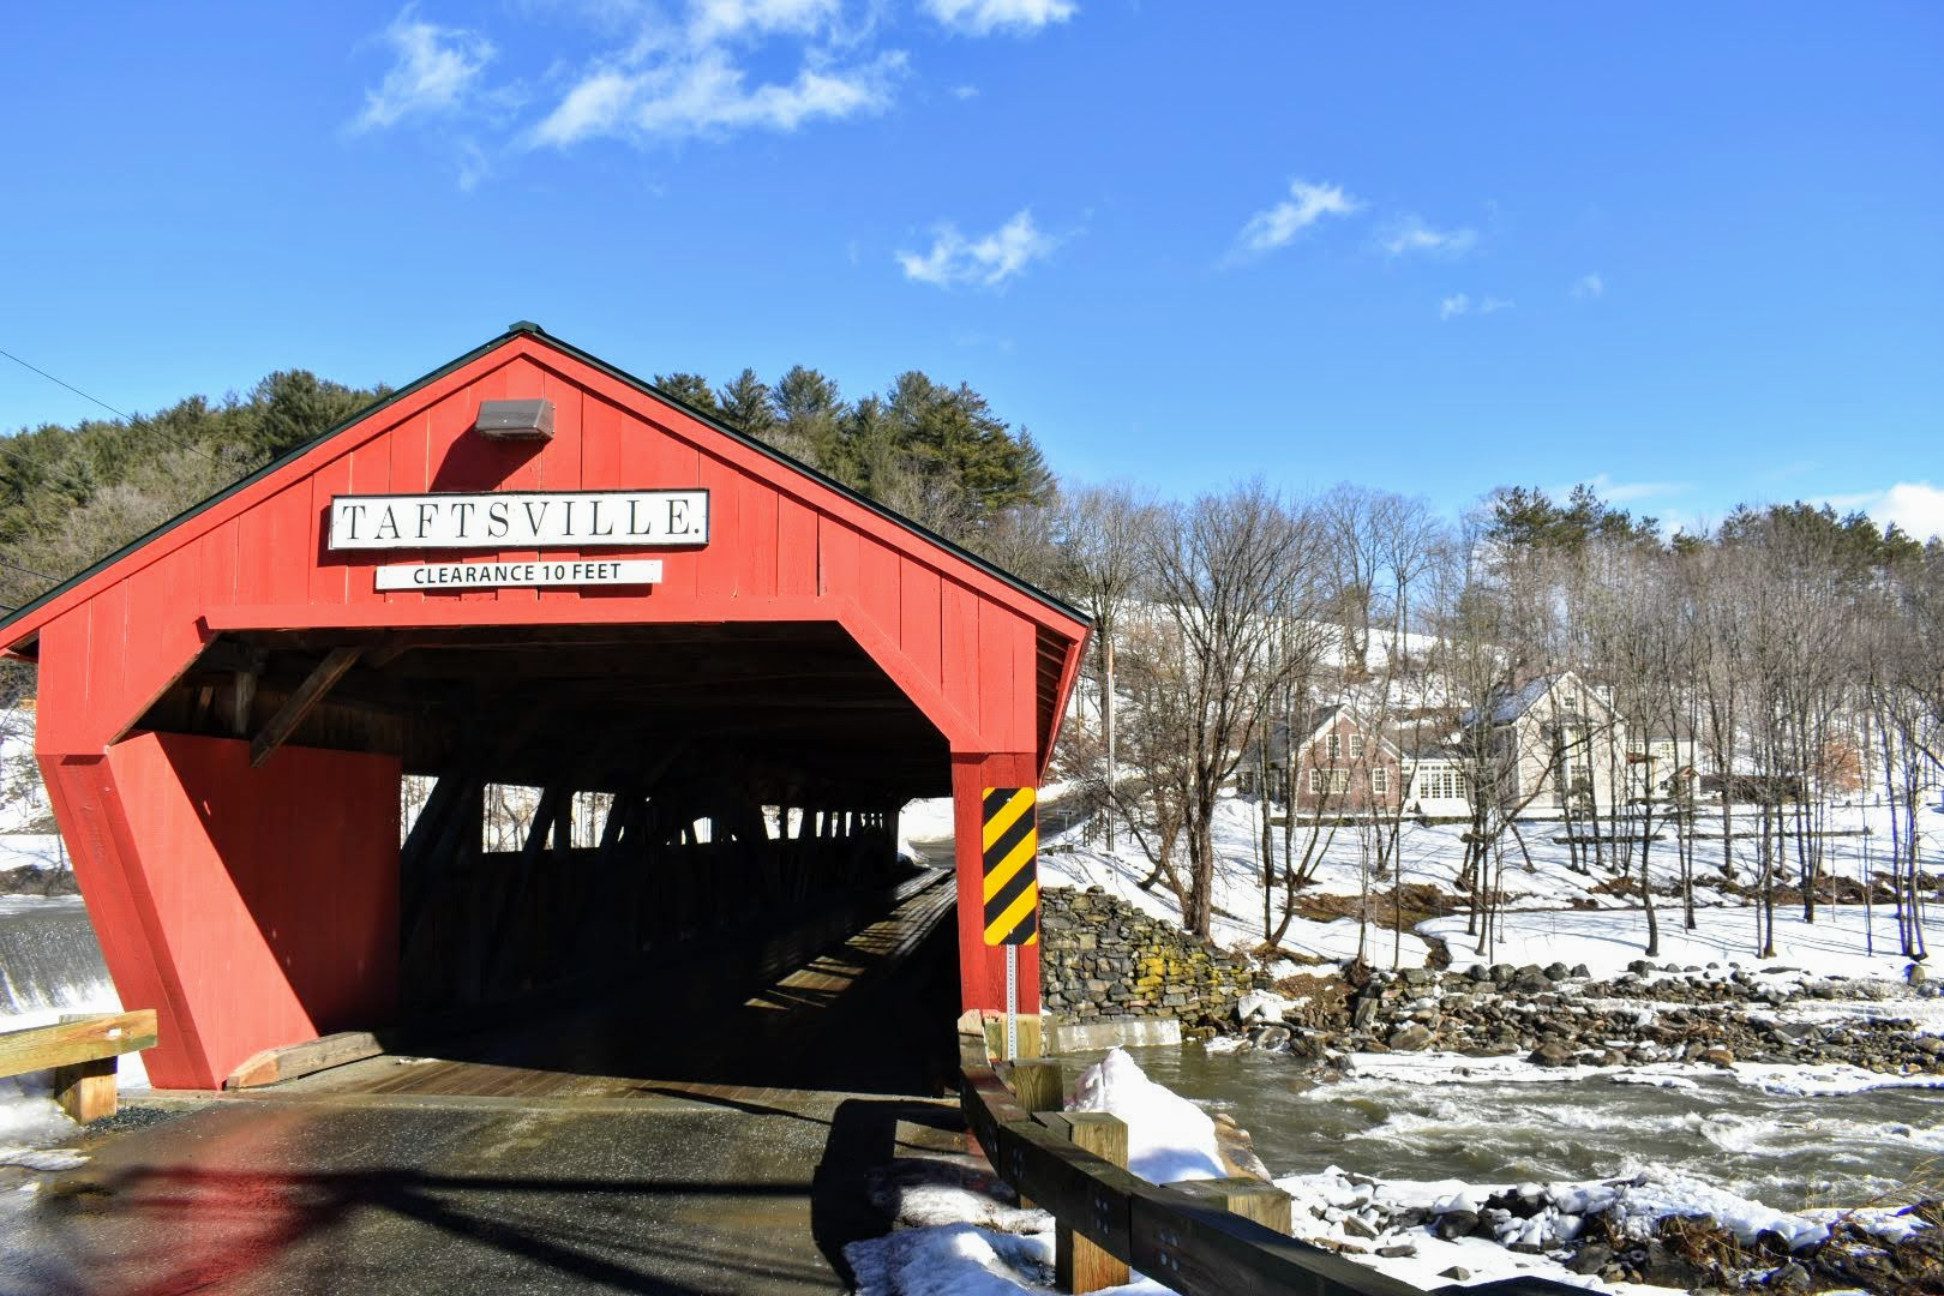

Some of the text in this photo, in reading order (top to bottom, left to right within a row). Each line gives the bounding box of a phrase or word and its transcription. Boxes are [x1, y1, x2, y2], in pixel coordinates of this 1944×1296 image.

[413, 563, 621, 584] CLEARANCE 10 FEET
